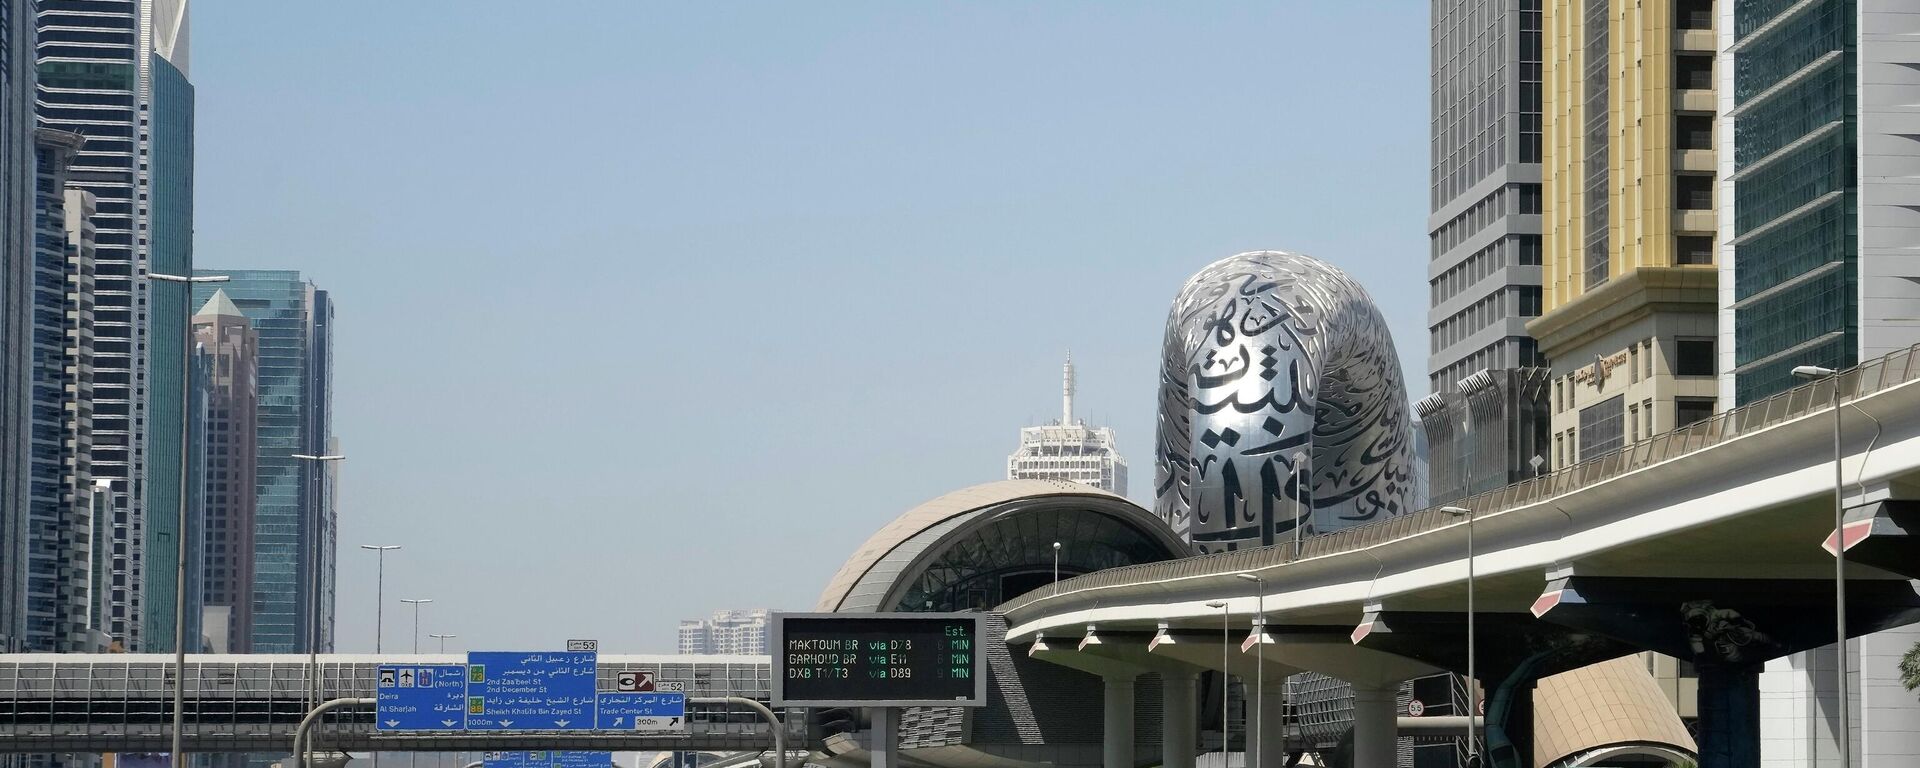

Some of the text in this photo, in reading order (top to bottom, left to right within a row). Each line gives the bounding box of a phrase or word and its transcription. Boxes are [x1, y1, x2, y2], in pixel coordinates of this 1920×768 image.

[945, 625, 967, 637] Est.
[583, 641, 595, 650] 53
[789, 639, 841, 650] MAKTOUM
[845, 639, 859, 650] BR
[869, 640, 886, 650] via
[890, 639, 912, 650] D78
[951, 639, 969, 650] MIN
[520, 654, 595, 665] شارع زعبيل الثاني
[789, 653, 839, 664] GARHOUD
[843, 653, 857, 664] BR
[869, 654, 886, 664] via
[890, 653, 907, 664] E11
[951, 653, 969, 664] MIN
[471, 672, 483, 681] 73
[502, 667, 594, 678] شارع الثاني من ديسمبر
[789, 667, 811, 678] DXB
[815, 667, 849, 678] T1/T3
[869, 668, 886, 678] via
[890, 667, 911, 678] D89
[951, 667, 969, 678] MIN
[670, 682, 682, 691] 52
[447, 692, 464, 700] ديرة
[518, 696, 542, 705] خليفة
[487, 697, 502, 705] زايد
[546, 696, 569, 706] الشيخ
[572, 697, 593, 706] شارع
[600, 696, 682, 706] شارع المركز التجاري
[389, 705, 417, 713] Sharjah
[434, 704, 464, 713] الشارقة
[470, 705, 482, 713] 88
[551, 708, 572, 716] Zayed
